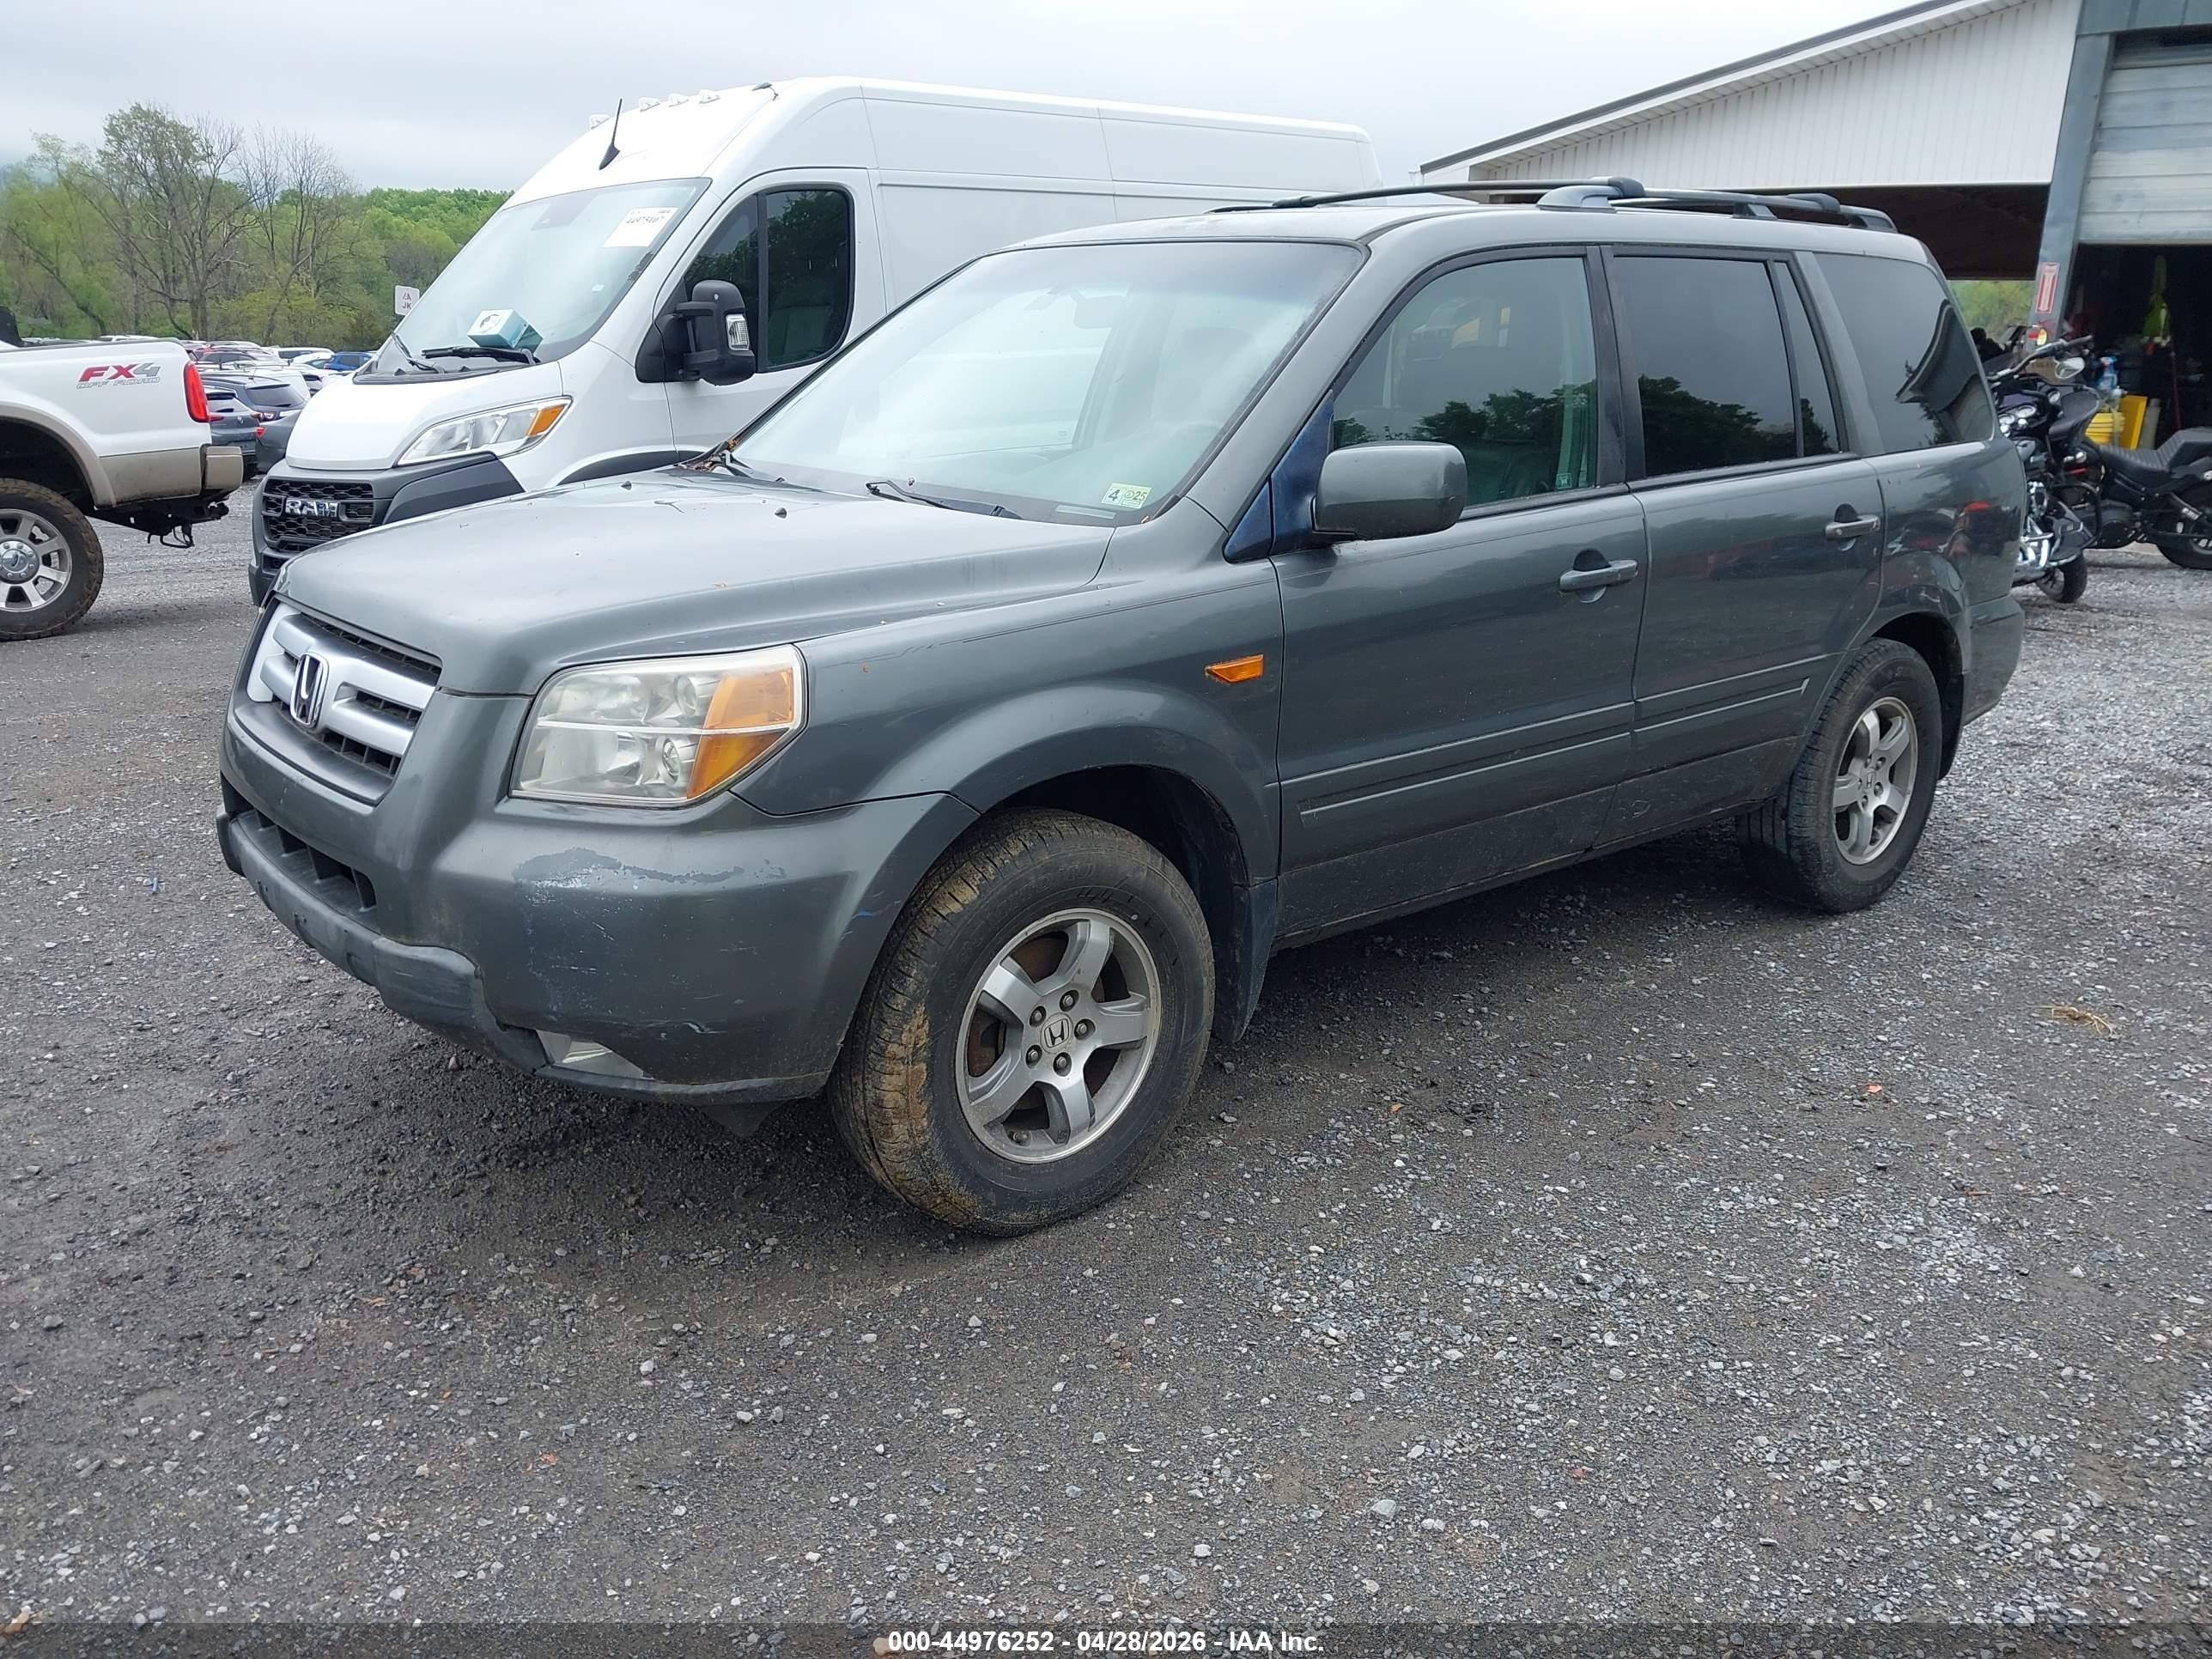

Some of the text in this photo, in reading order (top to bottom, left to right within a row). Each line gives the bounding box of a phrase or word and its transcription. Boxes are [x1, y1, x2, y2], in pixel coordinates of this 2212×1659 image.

[78, 362, 161, 383] FX4
[76, 376, 161, 390] OFF ROAD
[1108, 489, 1121, 501] 4
[285, 500, 338, 517] RAM
